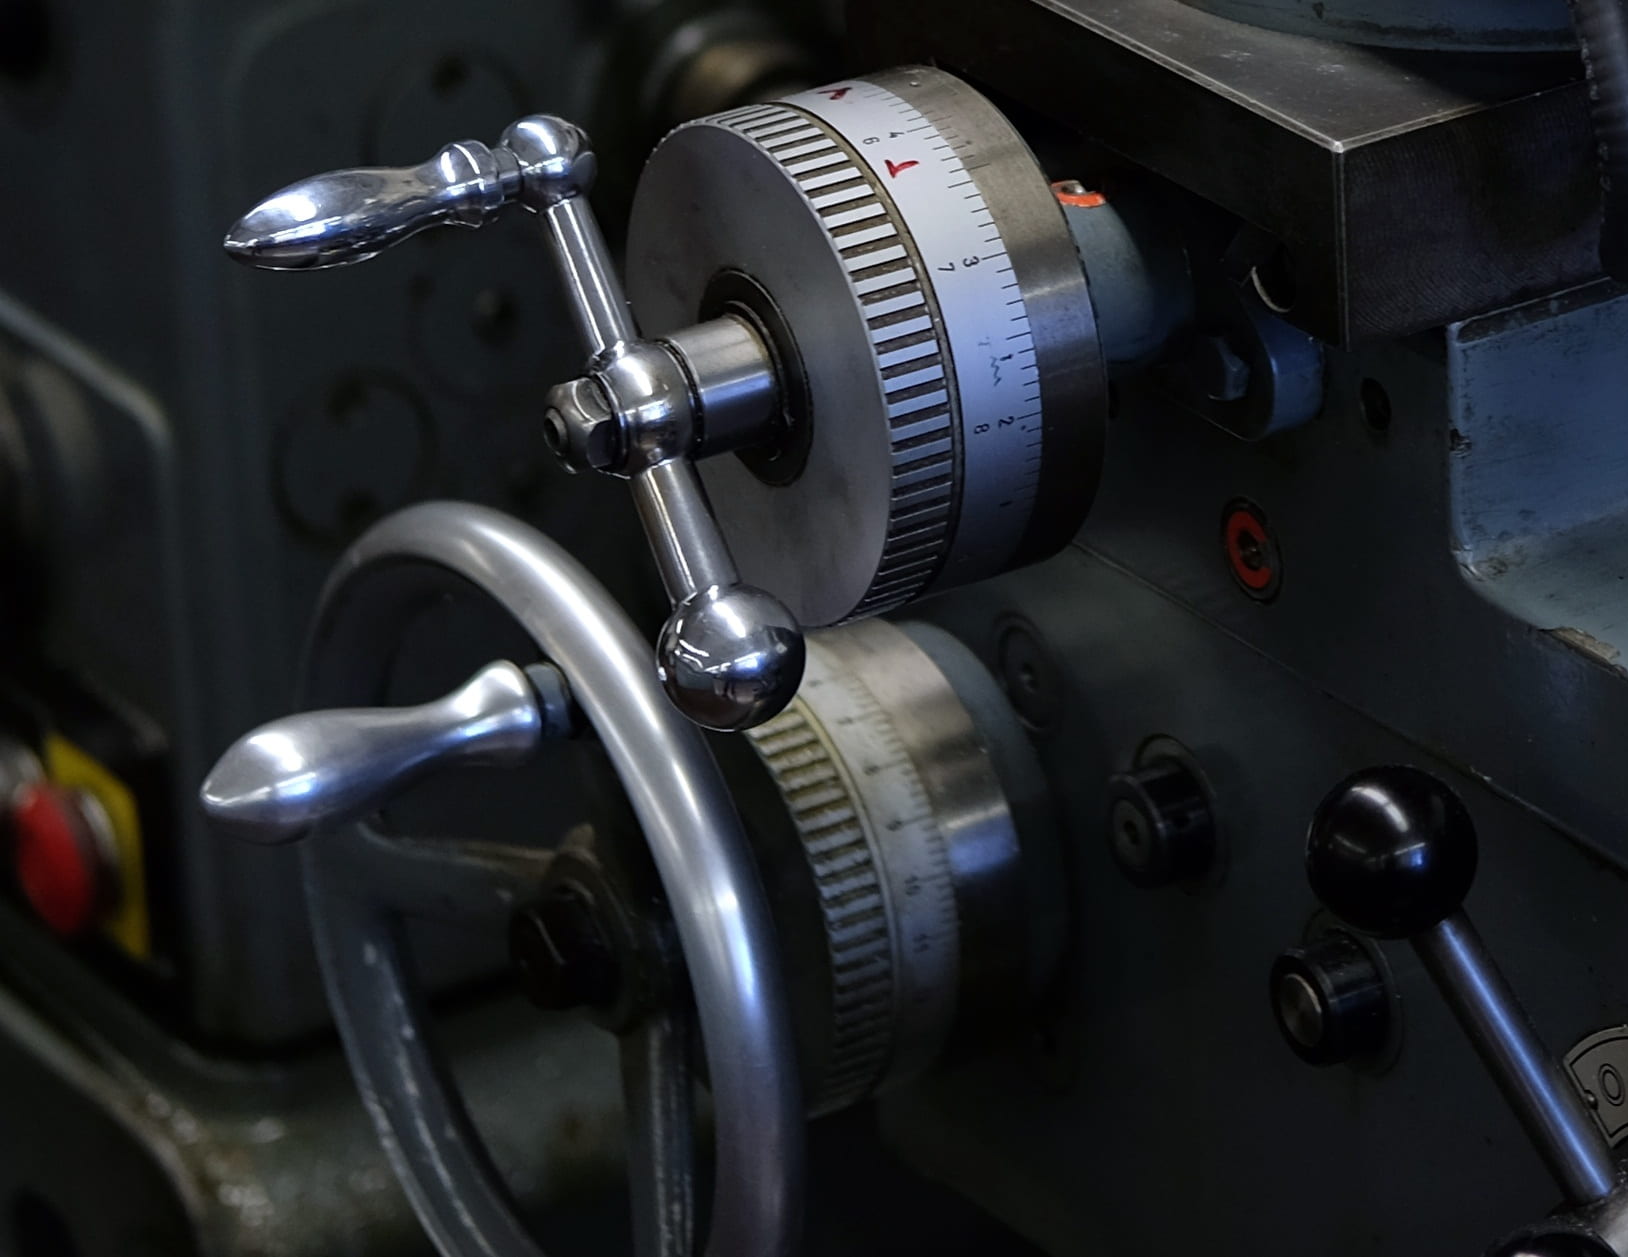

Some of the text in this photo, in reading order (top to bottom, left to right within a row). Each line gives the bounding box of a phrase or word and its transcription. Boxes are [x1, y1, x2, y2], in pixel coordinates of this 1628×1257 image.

[937, 262, 955, 271] 7
[962, 255, 980, 267] 3
[998, 415, 1015, 429] 2
[973, 423, 990, 435] 8
